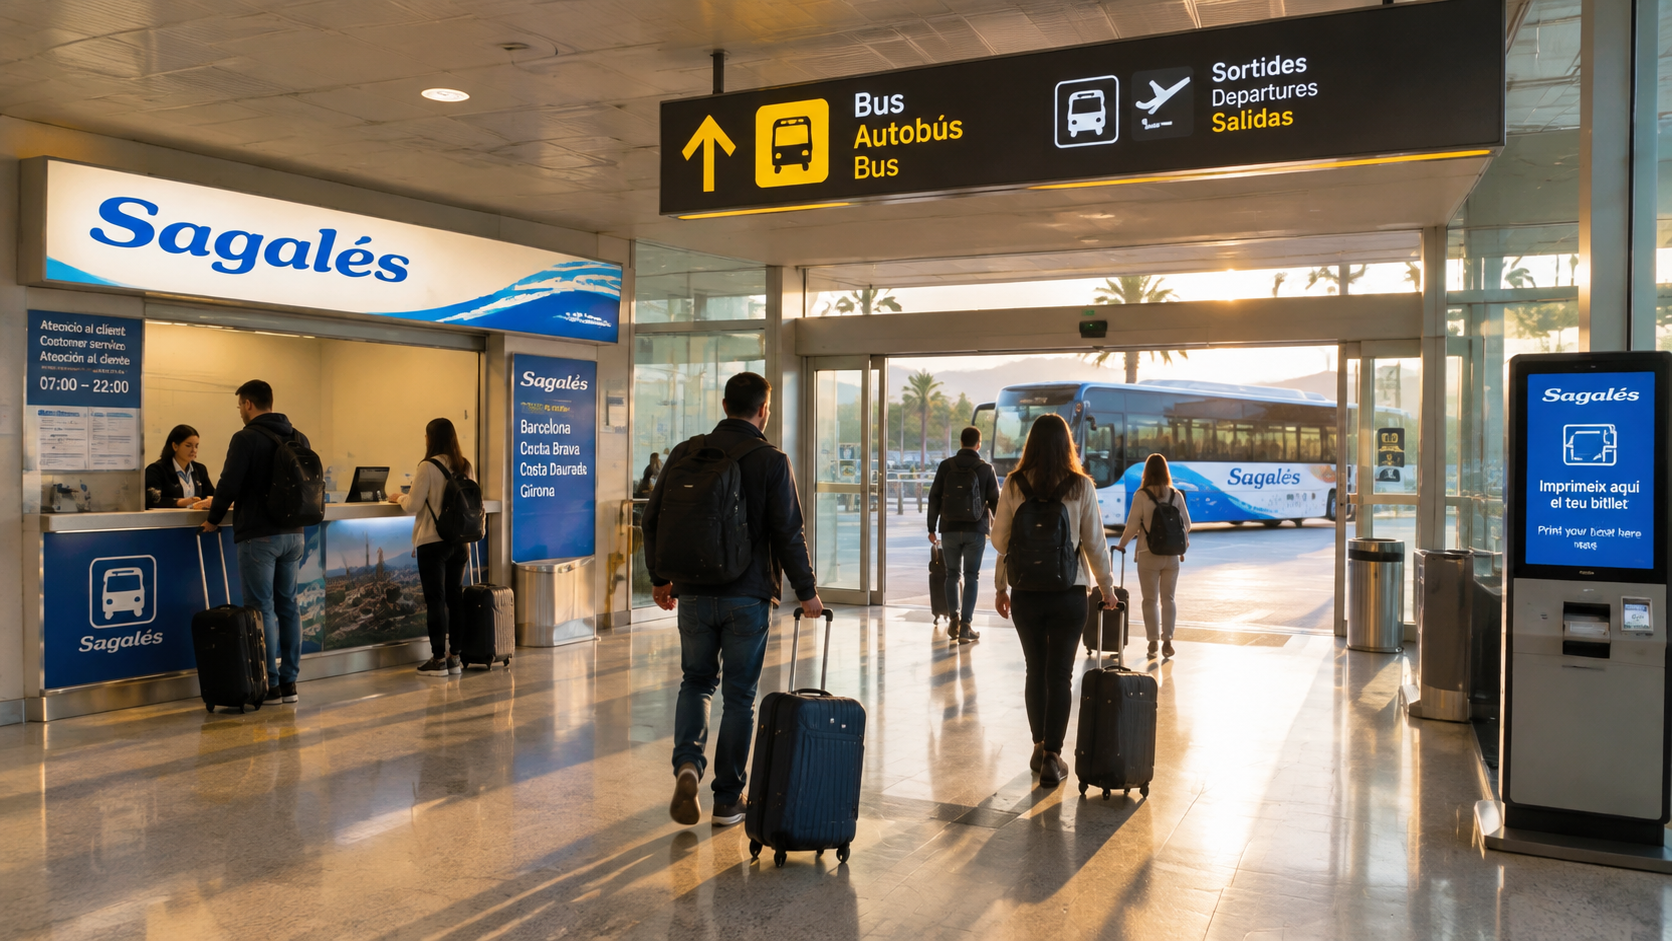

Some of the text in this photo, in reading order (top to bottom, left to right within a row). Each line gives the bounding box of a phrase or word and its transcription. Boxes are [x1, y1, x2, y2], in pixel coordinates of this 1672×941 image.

[1212, 55, 1307, 82] Sortides
[854, 92, 904, 118] Bus
[1212, 82, 1318, 108] Departures
[1212, 107, 1294, 133] Salidas
[853, 114, 963, 149] Autobús
[854, 155, 899, 179] Bus
[89, 196, 410, 283] Sagalés
[85, 324, 94, 334] al
[87, 353, 97, 364] al
[40, 376, 77, 391] 07:00
[93, 379, 129, 394] 22:00
[520, 371, 588, 393] Sagalés
[1542, 387, 1640, 406] Sagalés
[521, 418, 571, 435] Barcelona
[552, 442, 580, 456] Brava
[1227, 467, 1301, 490] Sagalés
[1539, 480, 1607, 495] Imprimeix
[1550, 497, 1629, 510] el teu bitllet
[78, 629, 164, 653] Sagalés
